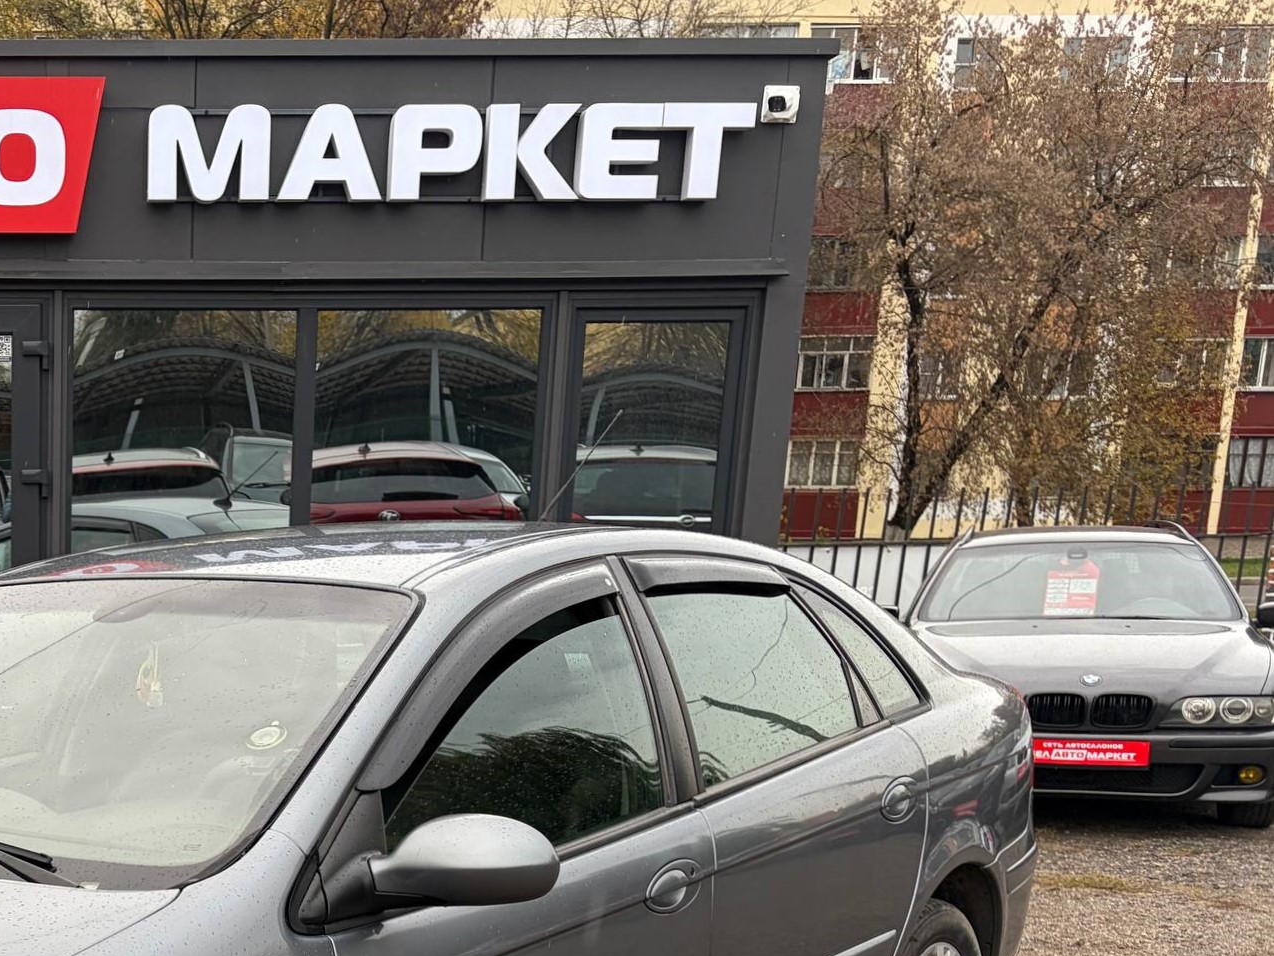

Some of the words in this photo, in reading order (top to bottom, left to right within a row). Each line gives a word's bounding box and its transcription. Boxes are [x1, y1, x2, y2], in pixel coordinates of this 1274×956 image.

[147, 102, 758, 203] МАРКЕТ
[1054, 751, 1085, 759] АВТО
[1087, 752, 1136, 760] МАРКЕТ
